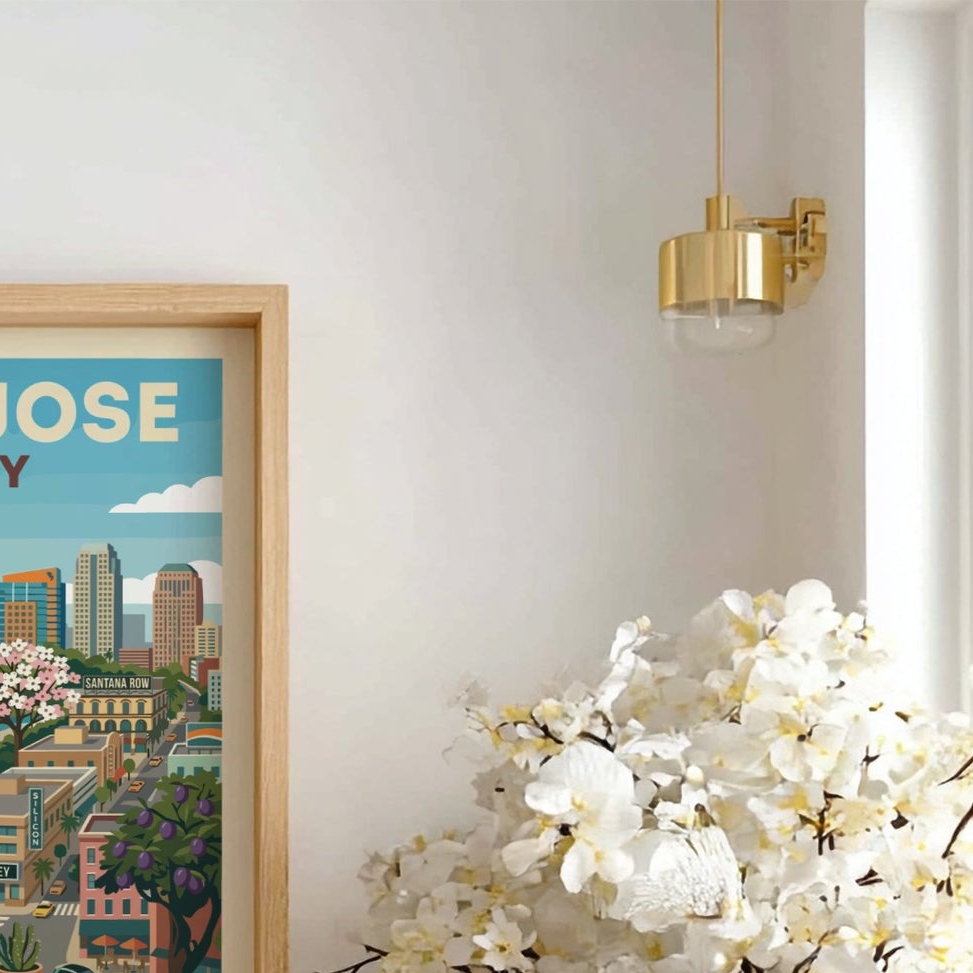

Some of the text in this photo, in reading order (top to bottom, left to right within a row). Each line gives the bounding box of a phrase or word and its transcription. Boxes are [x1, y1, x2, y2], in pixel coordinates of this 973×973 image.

[85, 677, 150, 689] SANTANA ROW
[31, 792, 40, 846] SILICON
